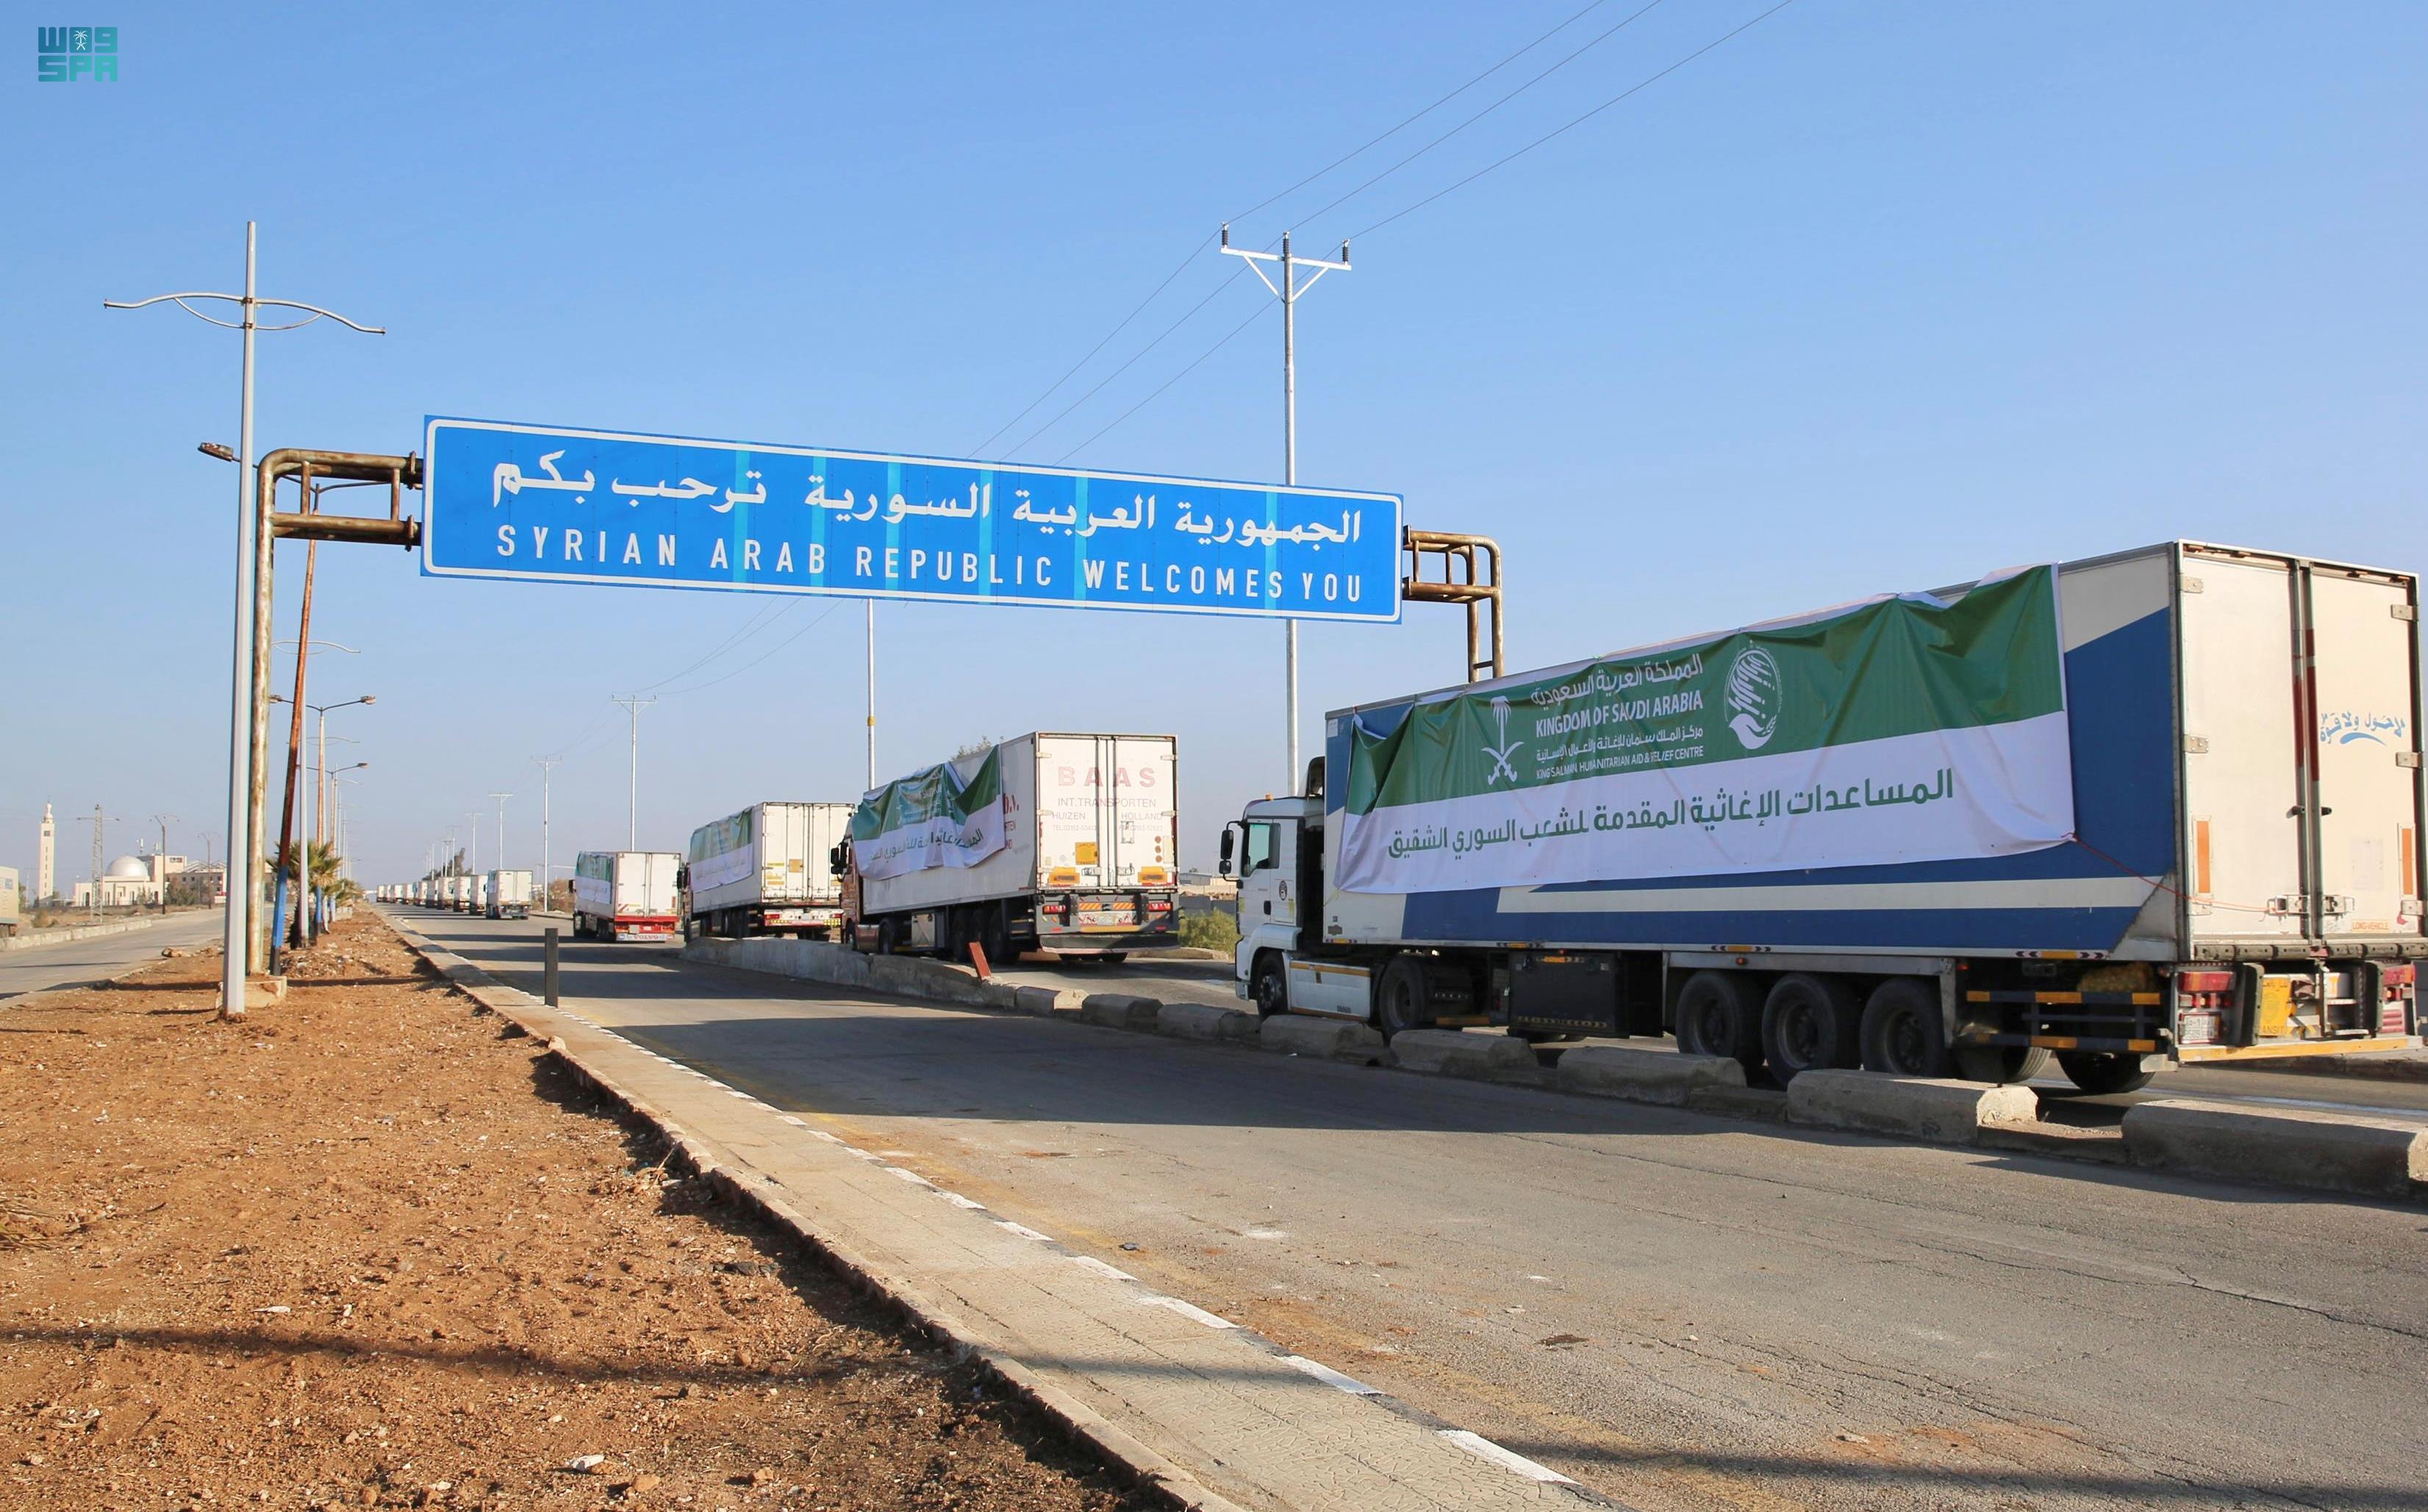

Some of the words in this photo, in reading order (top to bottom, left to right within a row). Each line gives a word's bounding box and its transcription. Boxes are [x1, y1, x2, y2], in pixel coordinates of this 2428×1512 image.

[493, 450, 595, 507] بكم
[612, 470, 767, 513] ترحب
[804, 474, 990, 524] السورية
[1012, 490, 1156, 537] العربية
[1175, 501, 1361, 551] الجمهورية
[497, 524, 676, 567] SYRIAN
[710, 537, 826, 574] ARAB
[856, 546, 1052, 586] REPUBLIC
[1083, 559, 1283, 599] WELCOMES
[1302, 572, 1361, 603] YOU
[1596, 666, 1642, 697] العربية
[1645, 653, 1703, 683] المملكة
[1530, 674, 1594, 711] السعودية
[1536, 708, 1591, 738] KINGDOM
[1593, 705, 1609, 725] OF
[1612, 698, 1650, 723] SAUDI
[1652, 689, 1703, 717] ARABIA
[1681, 724, 1704, 742] مركز
[1656, 726, 1680, 742] الملك
[1631, 753, 1644, 764] AID
[1675, 745, 1704, 760] CENTRE
[1058, 766, 1156, 788] BAAS
[1787, 767, 1953, 814] المساعدات
[1052, 811, 1086, 820] HUIZEN
[1121, 811, 1163, 820] HOLLAND
[1593, 800, 1686, 831] المقدمة
[1690, 787, 1780, 831] الإغاثية
[1388, 824, 1448, 859] الشقيق
[1452, 818, 1516, 860] السوري
